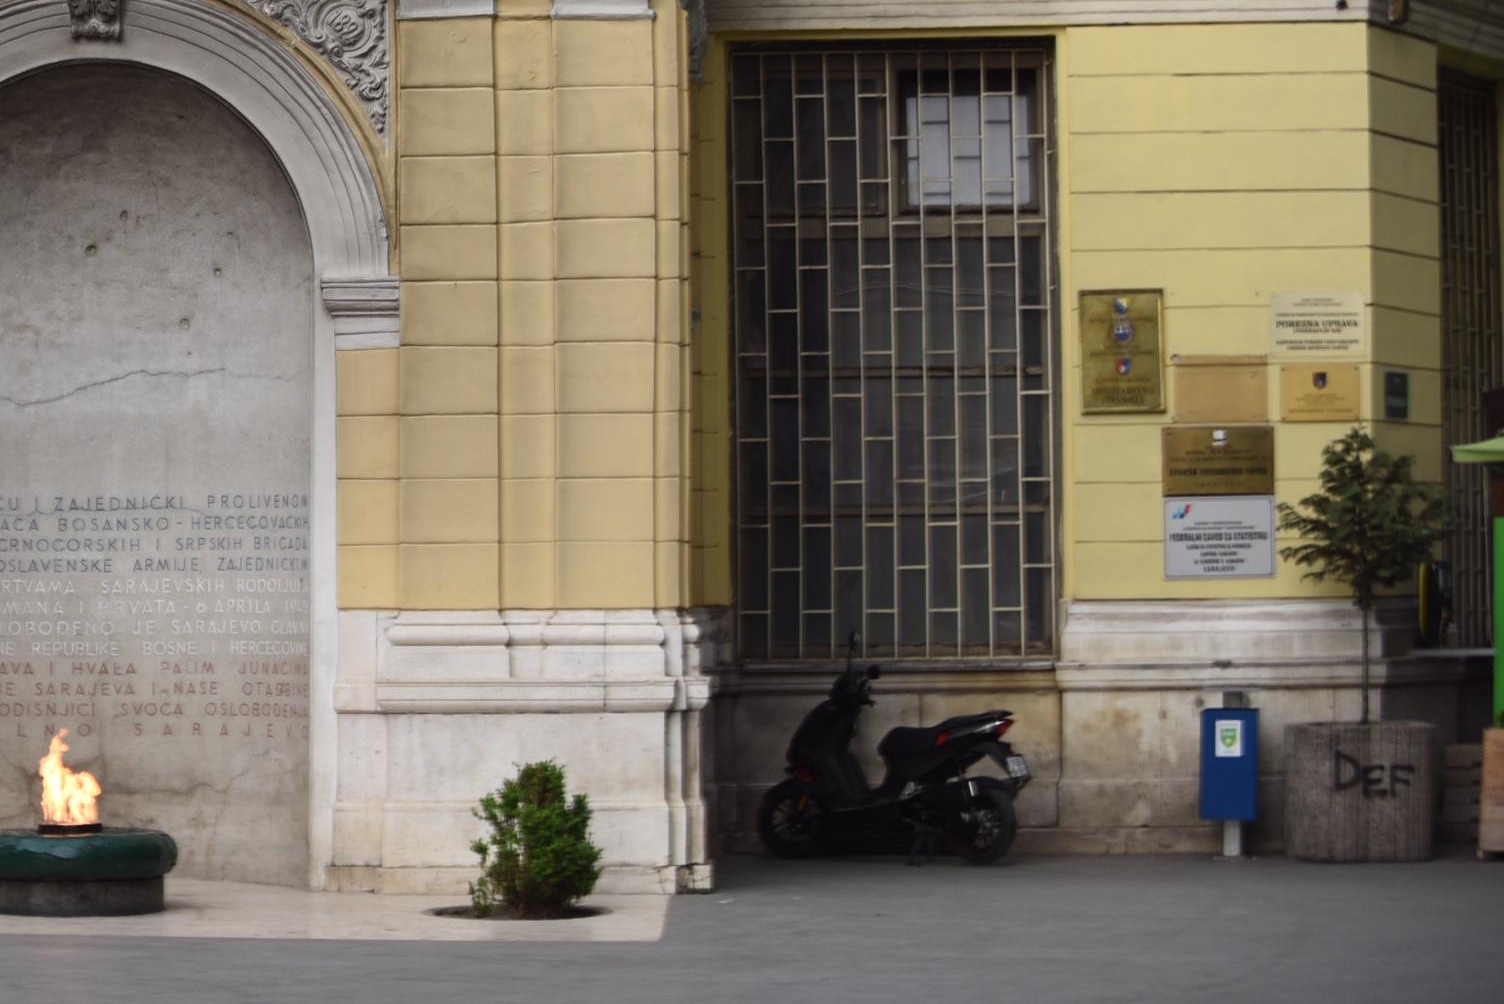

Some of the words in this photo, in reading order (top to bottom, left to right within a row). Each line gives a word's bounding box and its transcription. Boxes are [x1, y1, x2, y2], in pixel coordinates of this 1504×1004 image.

[207, 495, 308, 509] PROLIVENOM
[57, 516, 169, 532] BOSANSKO
[175, 537, 242, 552] SRPSKIH
[101, 578, 224, 594] SARAJEVSKIH
[197, 600, 206, 613] 6
[215, 599, 271, 613] APRILA
[131, 619, 156, 635] JE
[171, 620, 261, 635] SARAJEVO
[32, 641, 121, 656] REPUBLIKE
[143, 641, 198, 656] BOSNE
[34, 682, 136, 697] SARAJEVA
[1334, 750, 1415, 798] DEF
